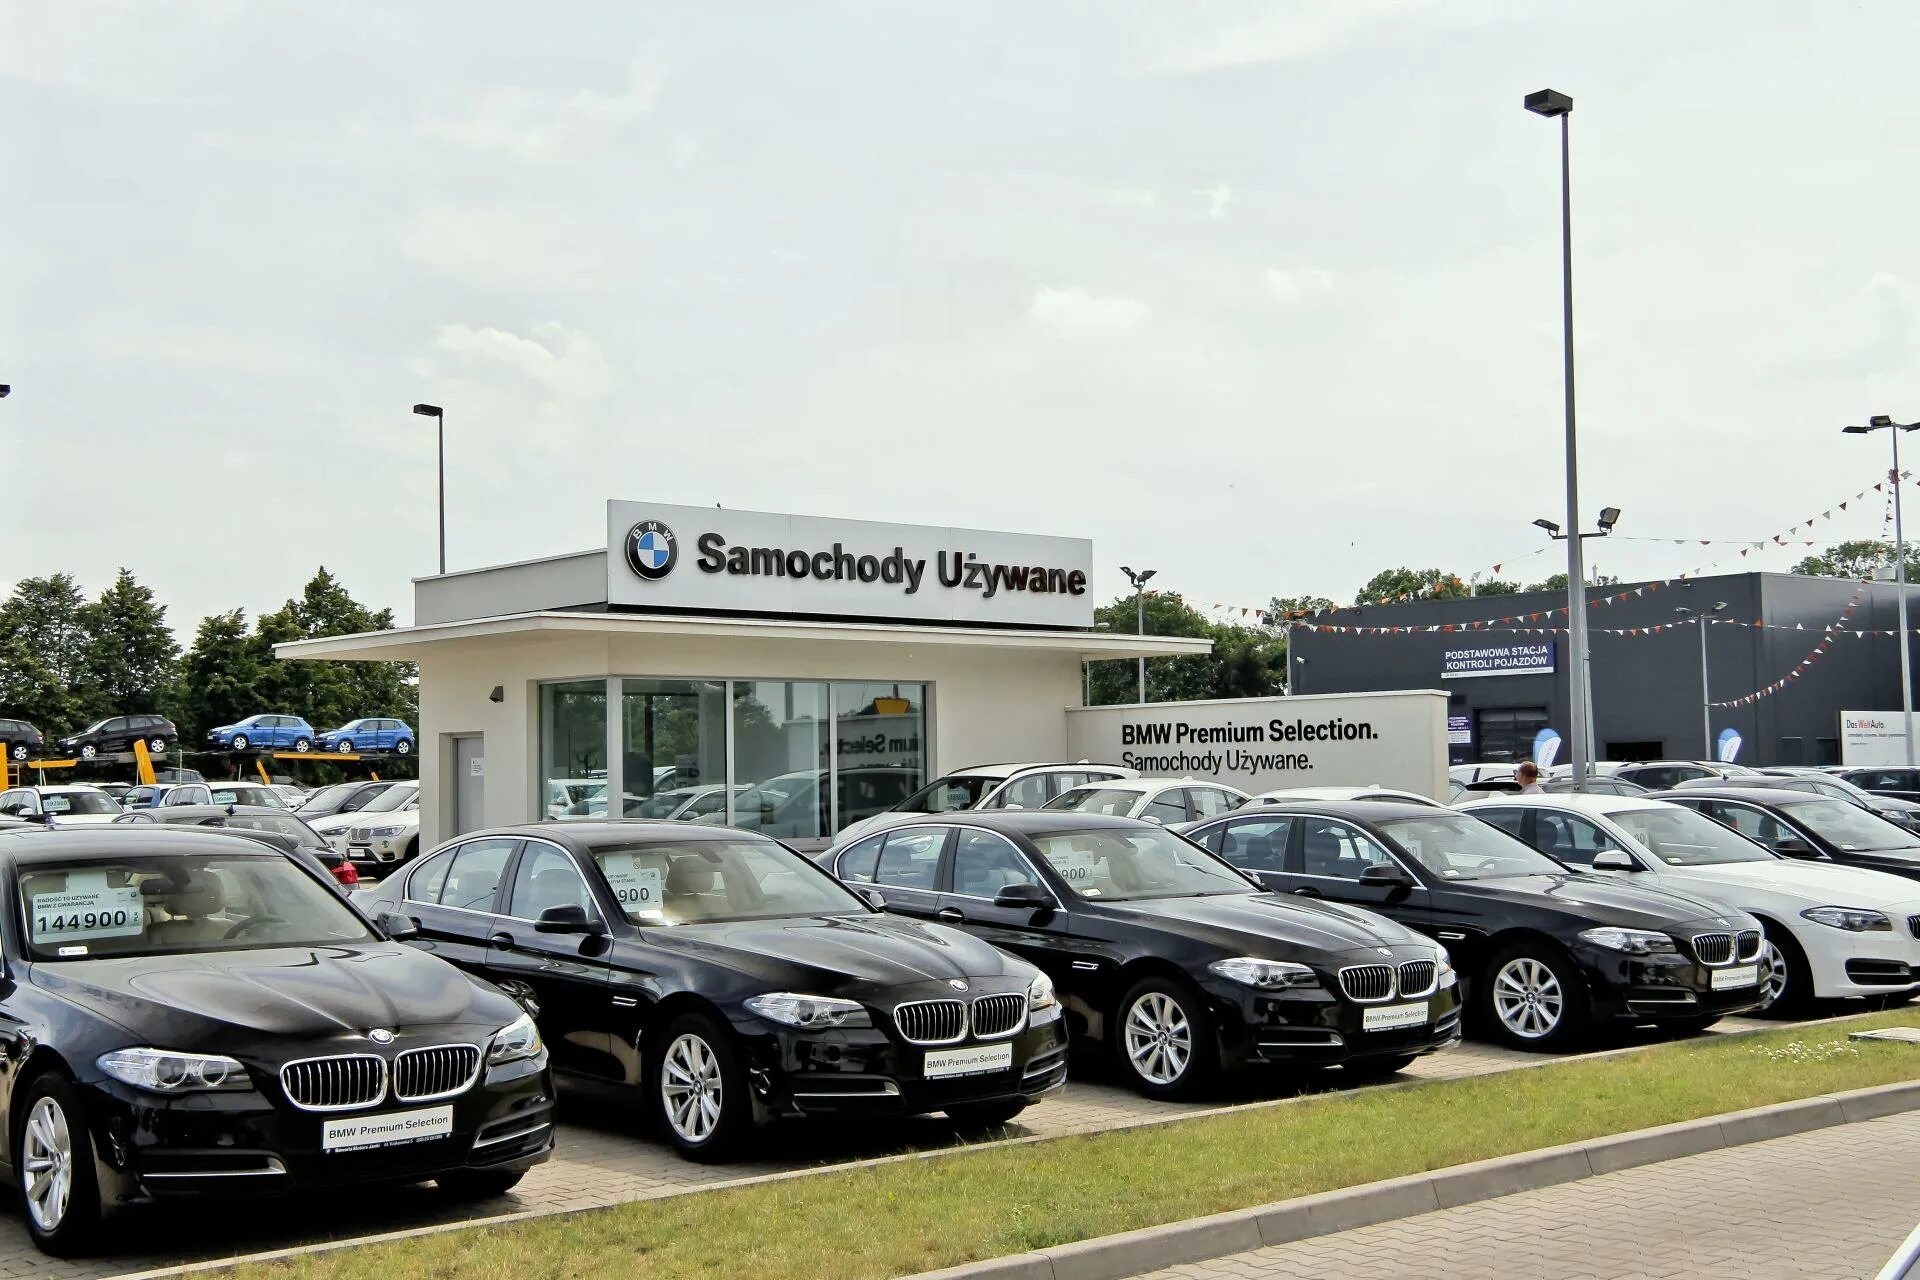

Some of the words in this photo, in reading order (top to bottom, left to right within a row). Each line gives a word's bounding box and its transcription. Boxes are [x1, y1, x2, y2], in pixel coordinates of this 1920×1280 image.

[632, 522, 674, 541] BMW
[697, 532, 927, 594] Samochody
[938, 550, 1087, 598] Używane
[1445, 648, 1510, 660] PODSTAWOWA
[1511, 645, 1548, 656] STACJA
[1446, 659, 1492, 670] KONTROLI
[1494, 655, 1548, 668] POJAZDÓW
[1122, 723, 1172, 745] BMW
[1176, 721, 1264, 744] Premium
[1268, 717, 1378, 741] Selection.
[1122, 750, 1223, 776] Samochody
[1226, 749, 1314, 775] Używane.
[38, 910, 126, 932] 144900
[927, 1060, 946, 1069] BMW
[947, 1056, 978, 1066] Premium
[980, 1052, 1010, 1063] Selection
[329, 1127, 357, 1139] BMW
[360, 1122, 404, 1135] Premium
[405, 1115, 448, 1129] Selection
